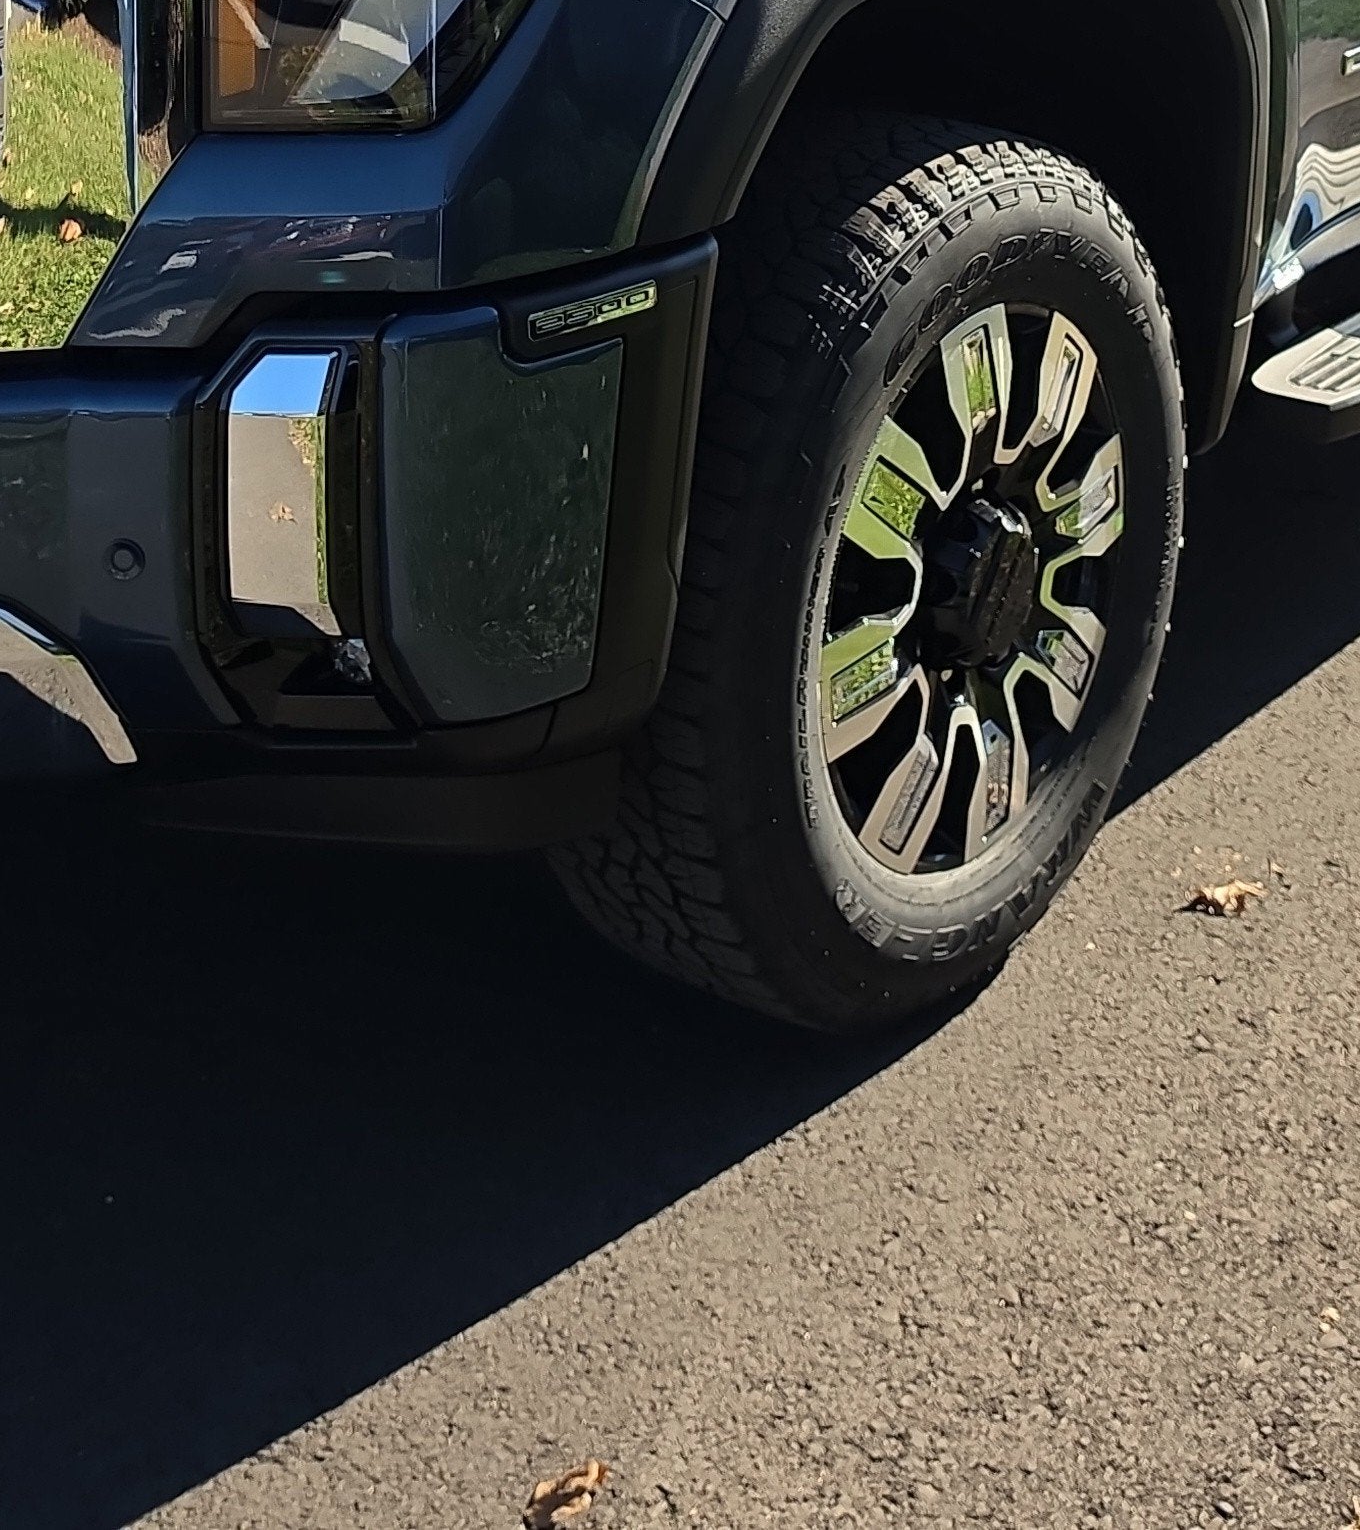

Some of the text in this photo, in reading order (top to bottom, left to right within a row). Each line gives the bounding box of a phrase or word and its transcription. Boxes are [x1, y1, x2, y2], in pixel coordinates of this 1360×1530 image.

[534, 290, 651, 335] 2500
[883, 226, 1155, 388] GOODYEAR
[833, 776, 1111, 963] WRANGLER
